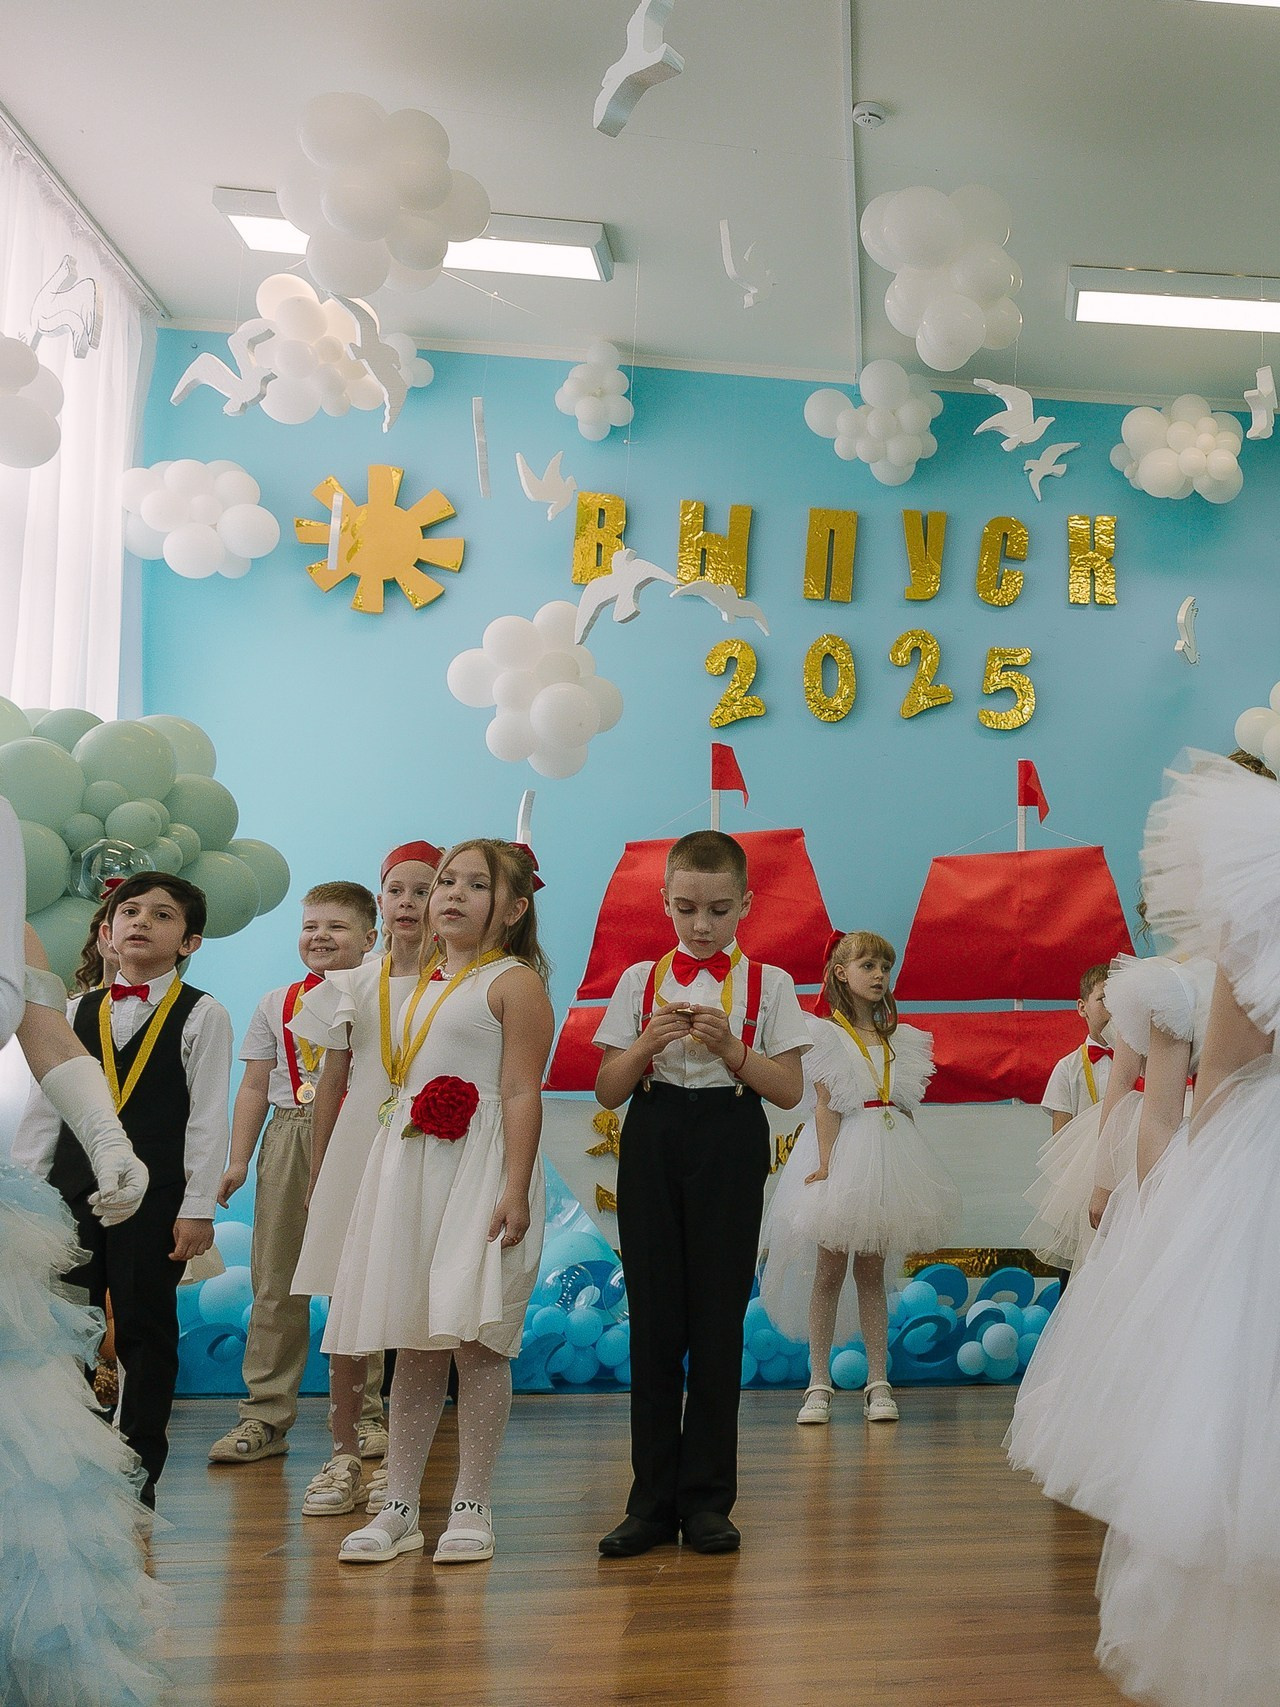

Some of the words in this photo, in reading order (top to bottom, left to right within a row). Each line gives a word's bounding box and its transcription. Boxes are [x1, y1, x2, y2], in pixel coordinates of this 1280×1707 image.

[571, 491, 1118, 606] ВЫПУСК
[705, 629, 1037, 730] 2025
[382, 1501, 410, 1518] OVE
[452, 1501, 483, 1516] OVE
